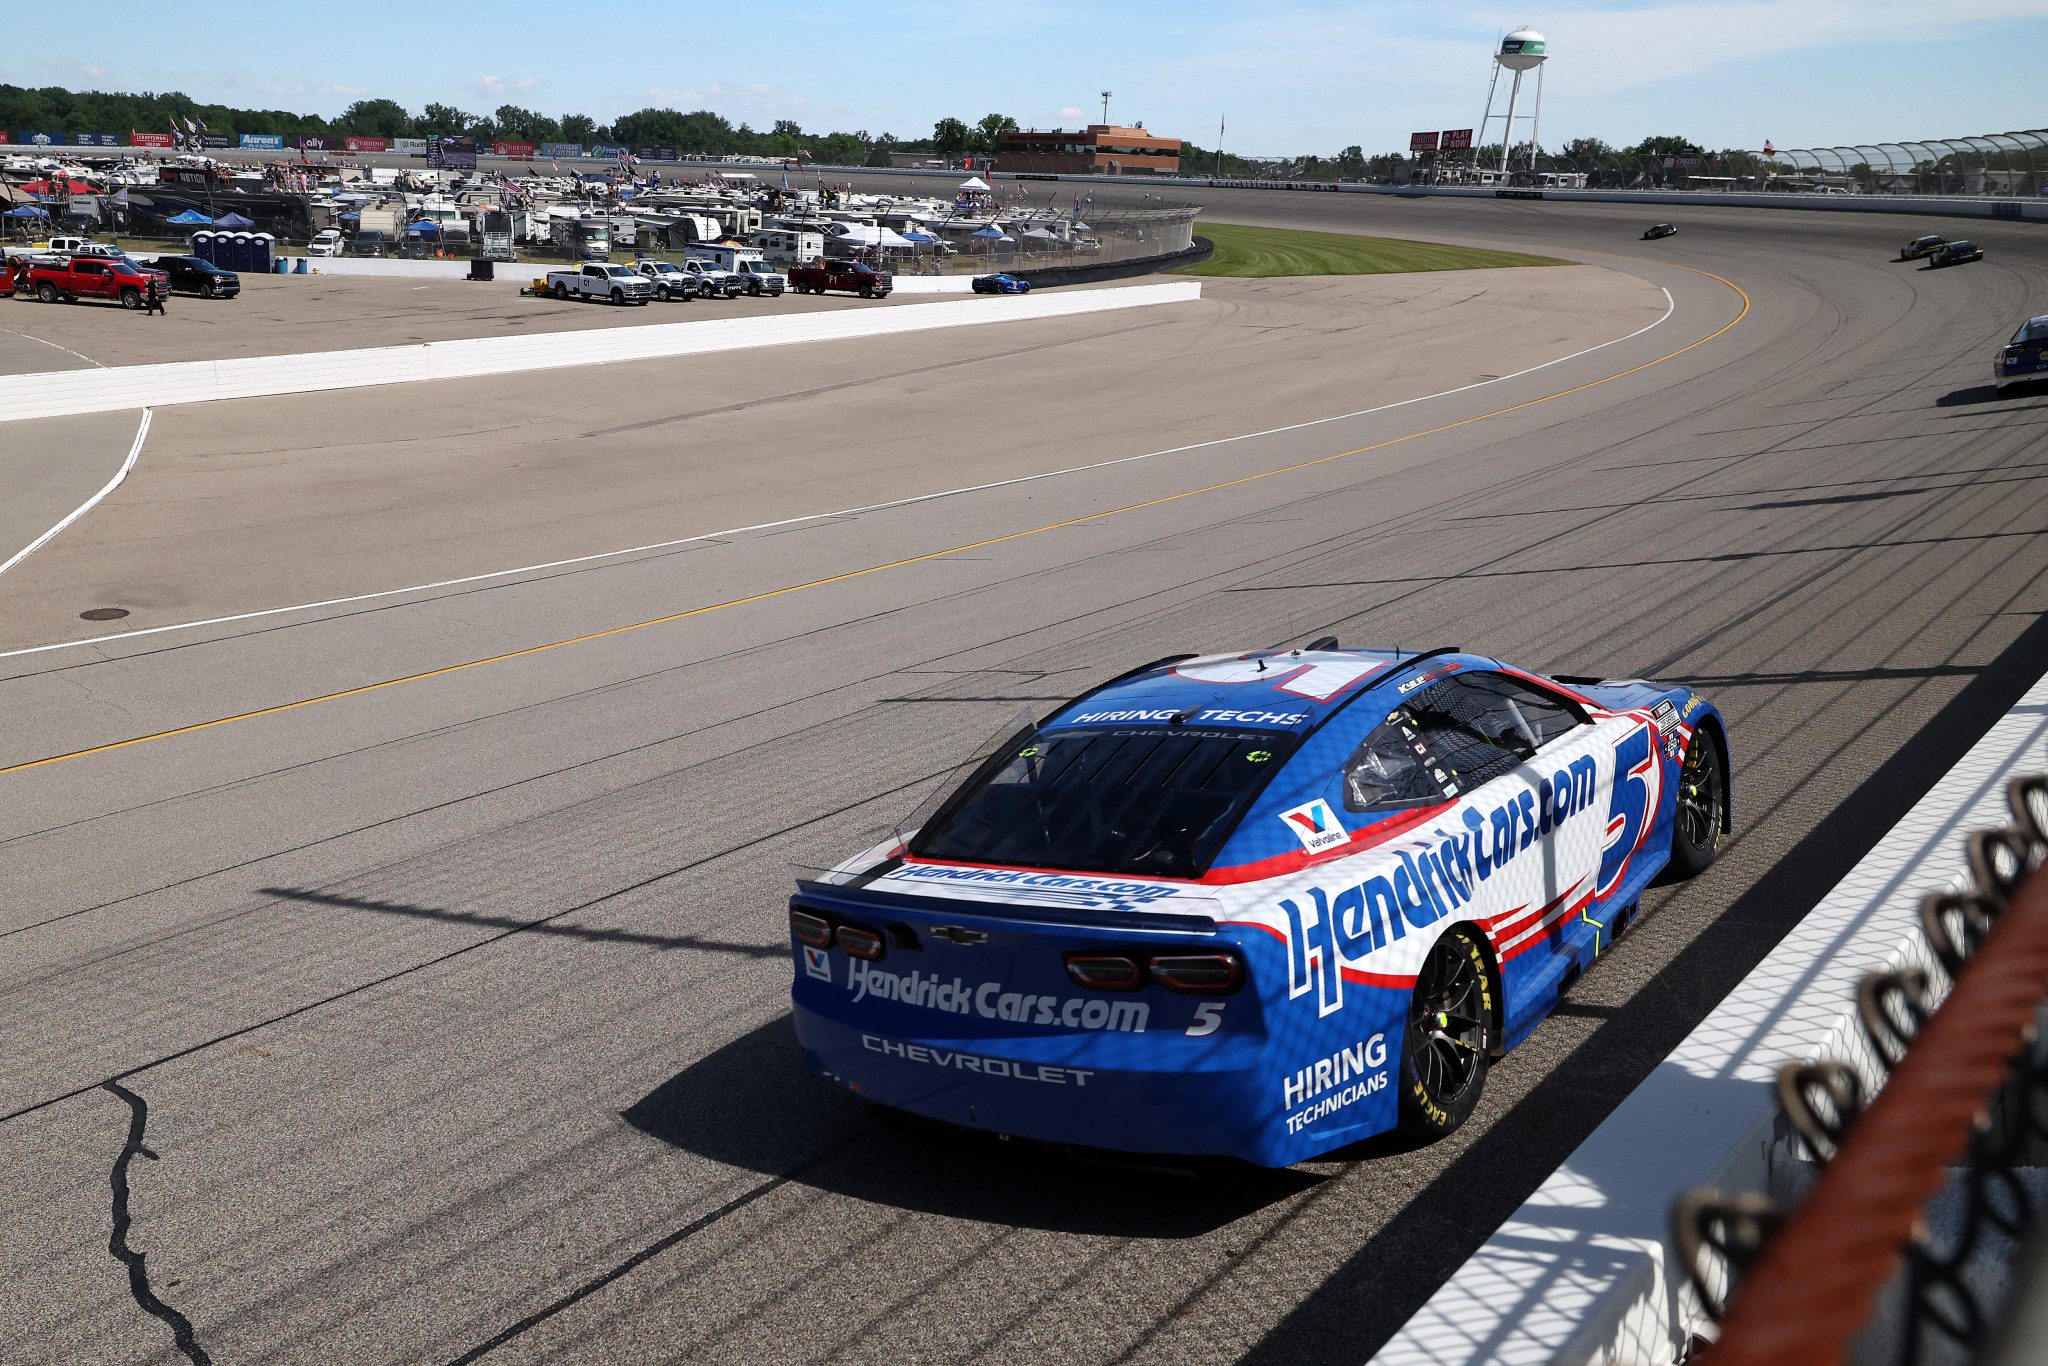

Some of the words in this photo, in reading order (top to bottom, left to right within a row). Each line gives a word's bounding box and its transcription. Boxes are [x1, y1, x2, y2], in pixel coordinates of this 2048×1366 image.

[243, 135, 280, 144] Aaron's
[306, 138, 323, 148] ally
[1450, 139, 1469, 147] NOW!
[1453, 131, 1470, 139] PLAY
[583, 279, 590, 287] C1
[829, 275, 838, 284] F1
[1072, 709, 1182, 724] HIRING
[1198, 709, 1312, 725] TECHS
[1112, 730, 1276, 741] CHEVROLET
[1308, 832, 1342, 848] Valvoline
[892, 865, 1180, 898] HendrickCars.com
[1279, 754, 1597, 1019] HendrickCars.com
[846, 956, 1150, 1034] HendrickCars.com
[1184, 1001, 1226, 1037] 5
[861, 1034, 1095, 1087] CHEVROLET
[1283, 1032, 1387, 1111] HIRING
[1285, 1069, 1389, 1136] TECHNICIANS
[1413, 1080, 1447, 1127] EAGLE
